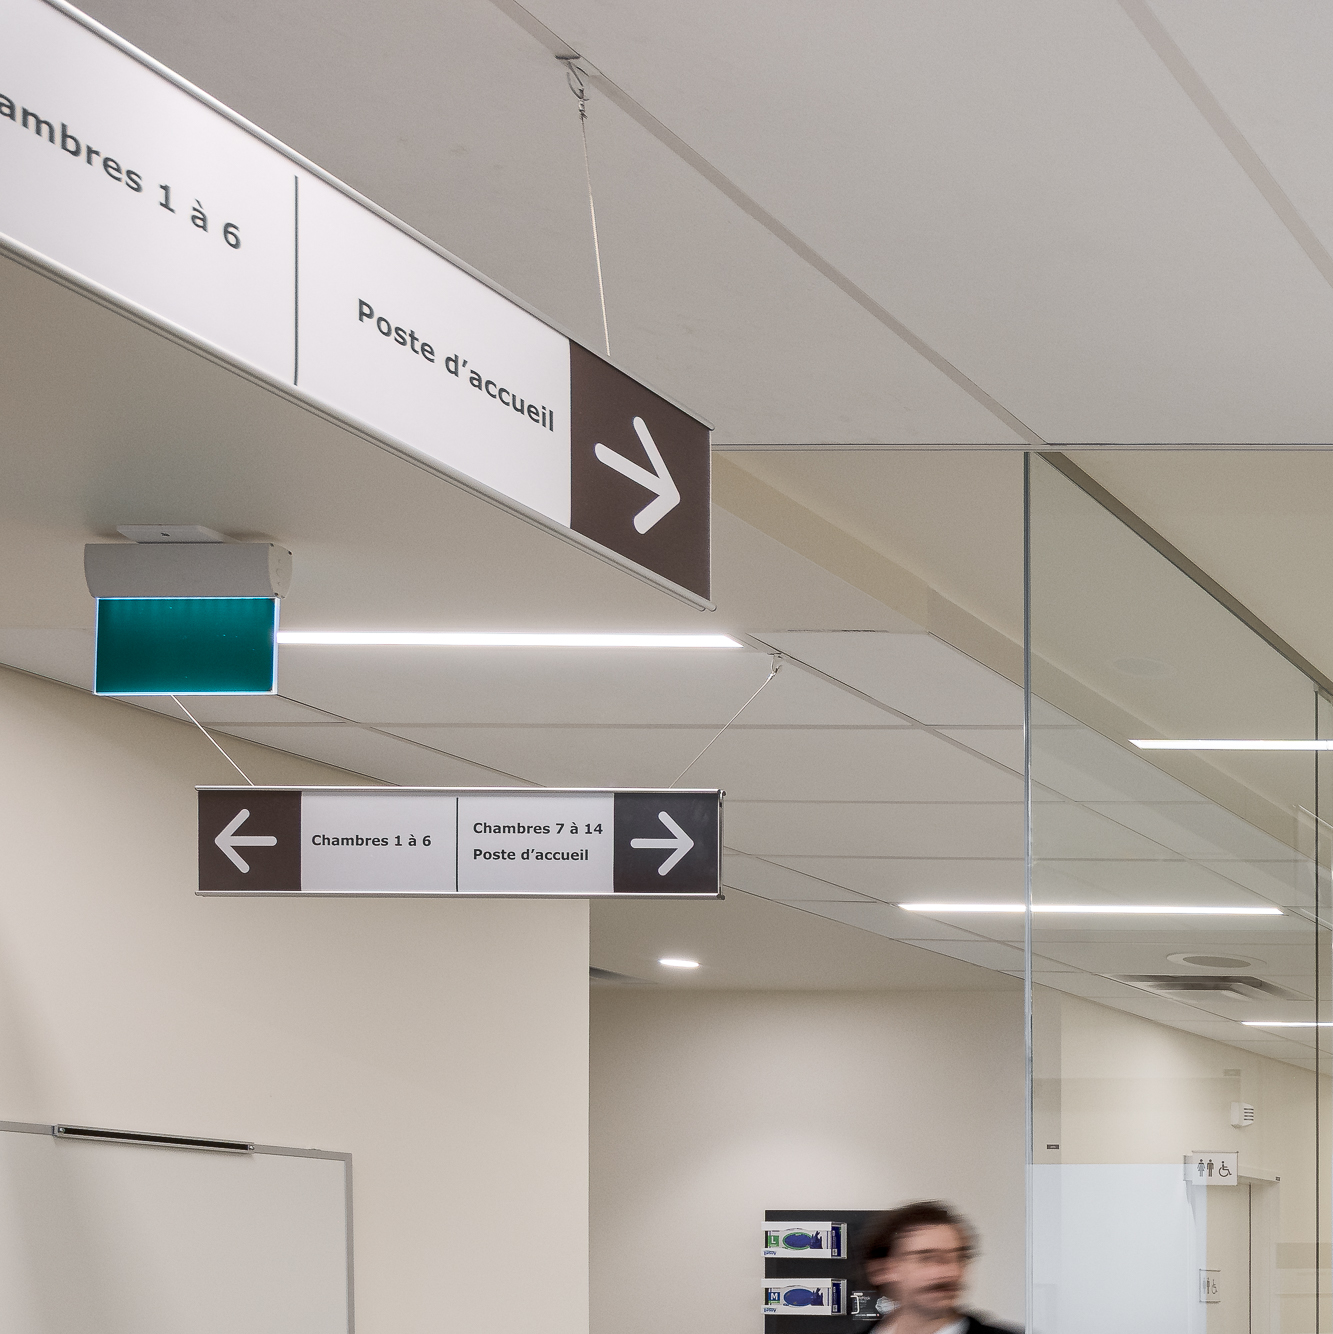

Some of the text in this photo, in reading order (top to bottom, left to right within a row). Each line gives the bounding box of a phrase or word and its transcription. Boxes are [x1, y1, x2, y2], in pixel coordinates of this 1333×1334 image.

[158, 183, 176, 215] 1
[190, 197, 209, 234] à
[222, 221, 242, 251] 6
[357, 297, 436, 364] Poste
[472, 821, 604, 835] Chambres 7 à 14
[311, 833, 432, 847] Chambres 1 à 6
[473, 848, 516, 861] Poste
